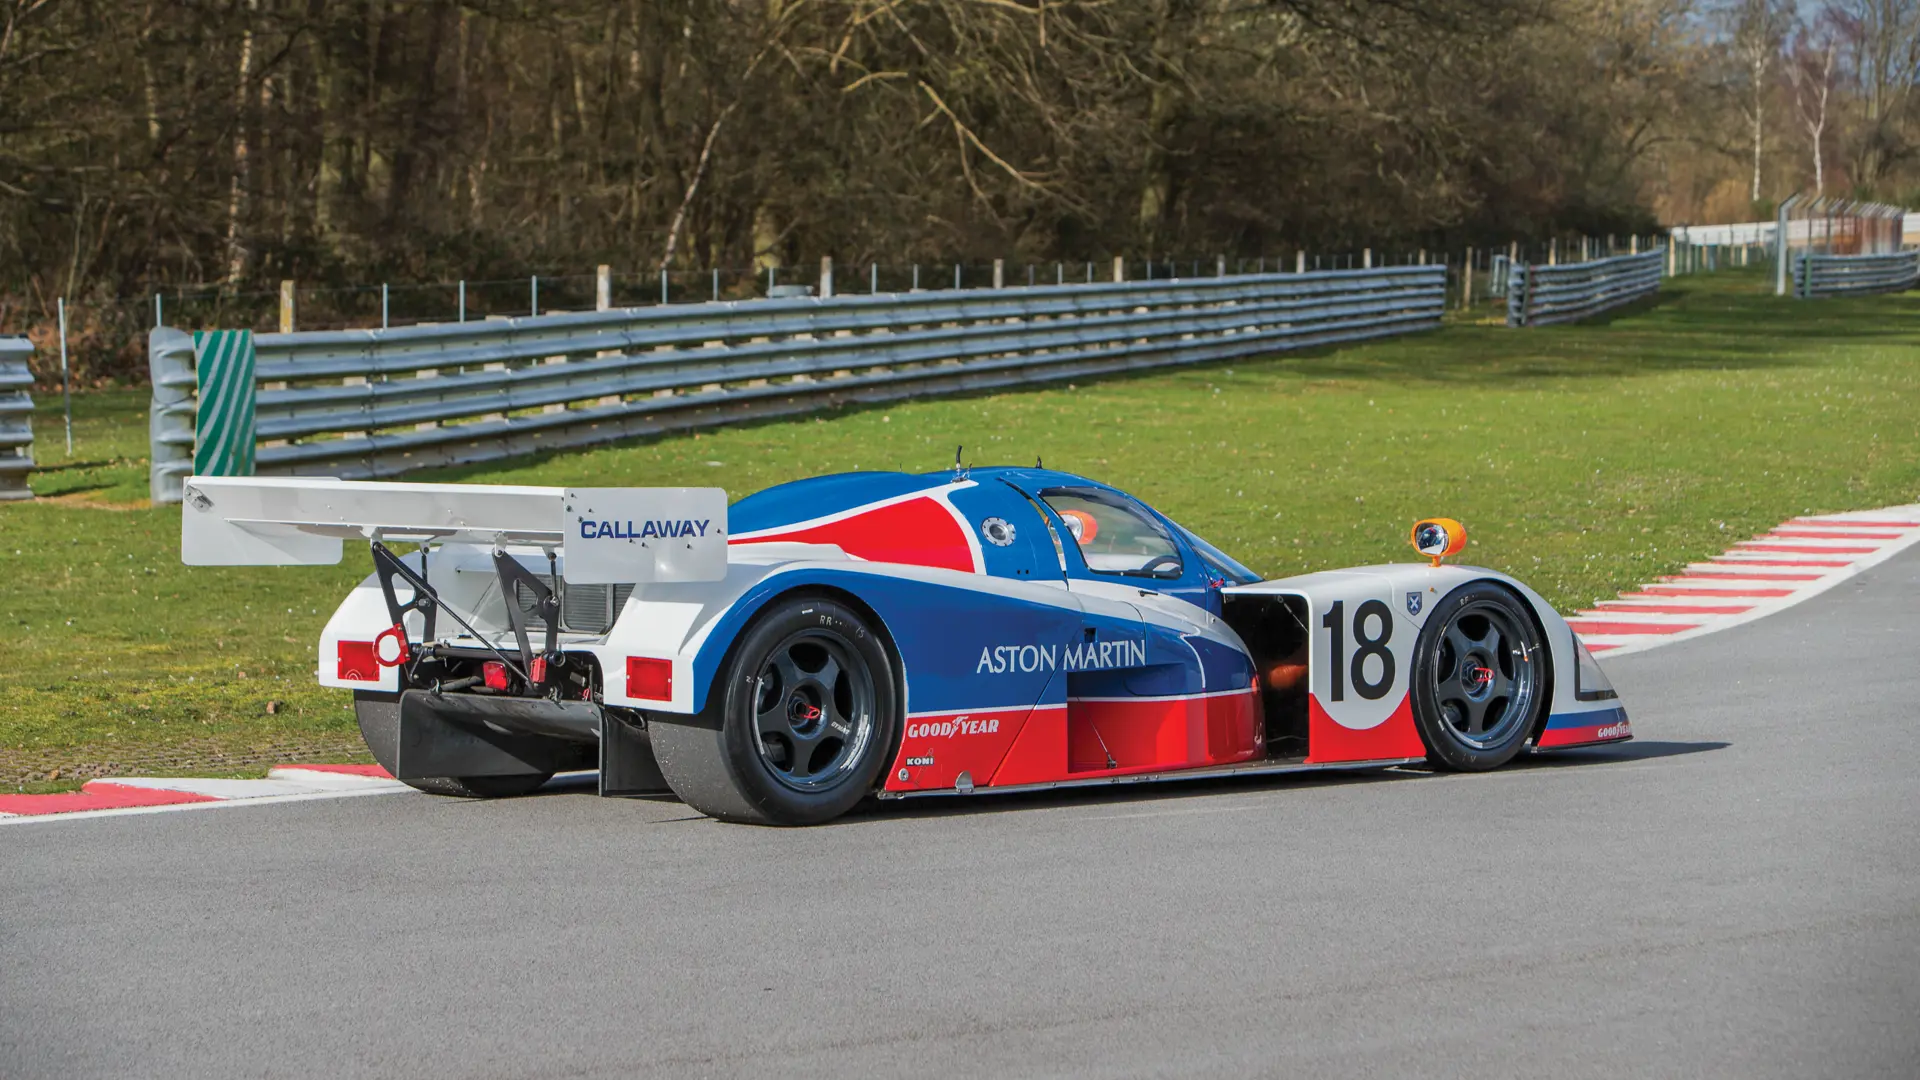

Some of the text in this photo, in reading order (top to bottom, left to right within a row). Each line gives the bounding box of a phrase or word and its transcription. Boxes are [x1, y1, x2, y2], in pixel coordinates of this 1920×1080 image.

[580, 519, 710, 539] CALLAWAY
[976, 639, 1147, 674] ASTON MARTIN
[1322, 599, 1396, 702] 18
[908, 716, 999, 739] GOODYEAR
[1597, 721, 1631, 738] GOODYEA
[906, 757, 934, 766] KONI
